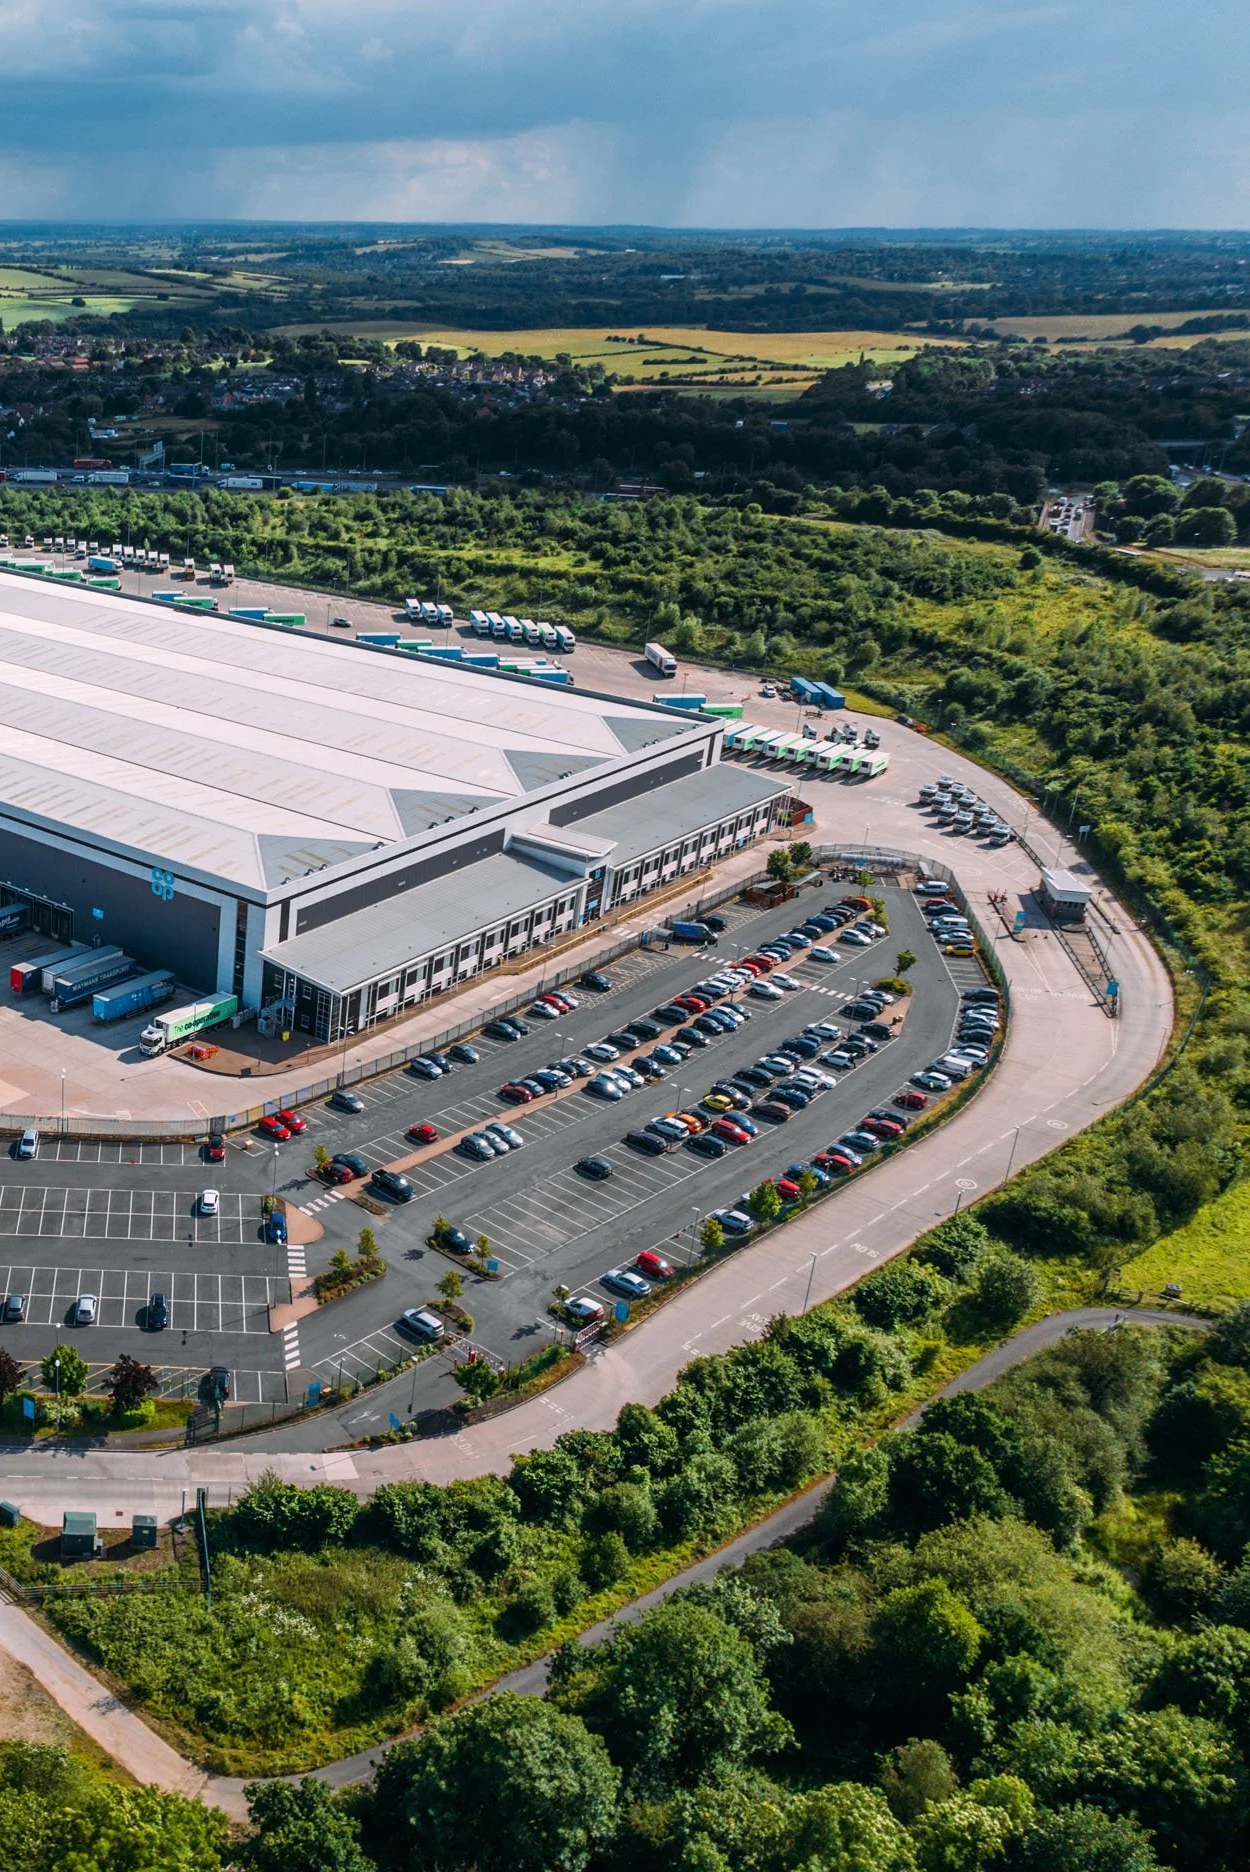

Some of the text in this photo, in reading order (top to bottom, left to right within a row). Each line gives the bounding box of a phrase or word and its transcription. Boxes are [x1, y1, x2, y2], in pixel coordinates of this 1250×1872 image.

[100, 966, 130, 981] TRANSPORT
[174, 1025, 184, 1034] The
[850, 1243, 880, 1258] SLOW
